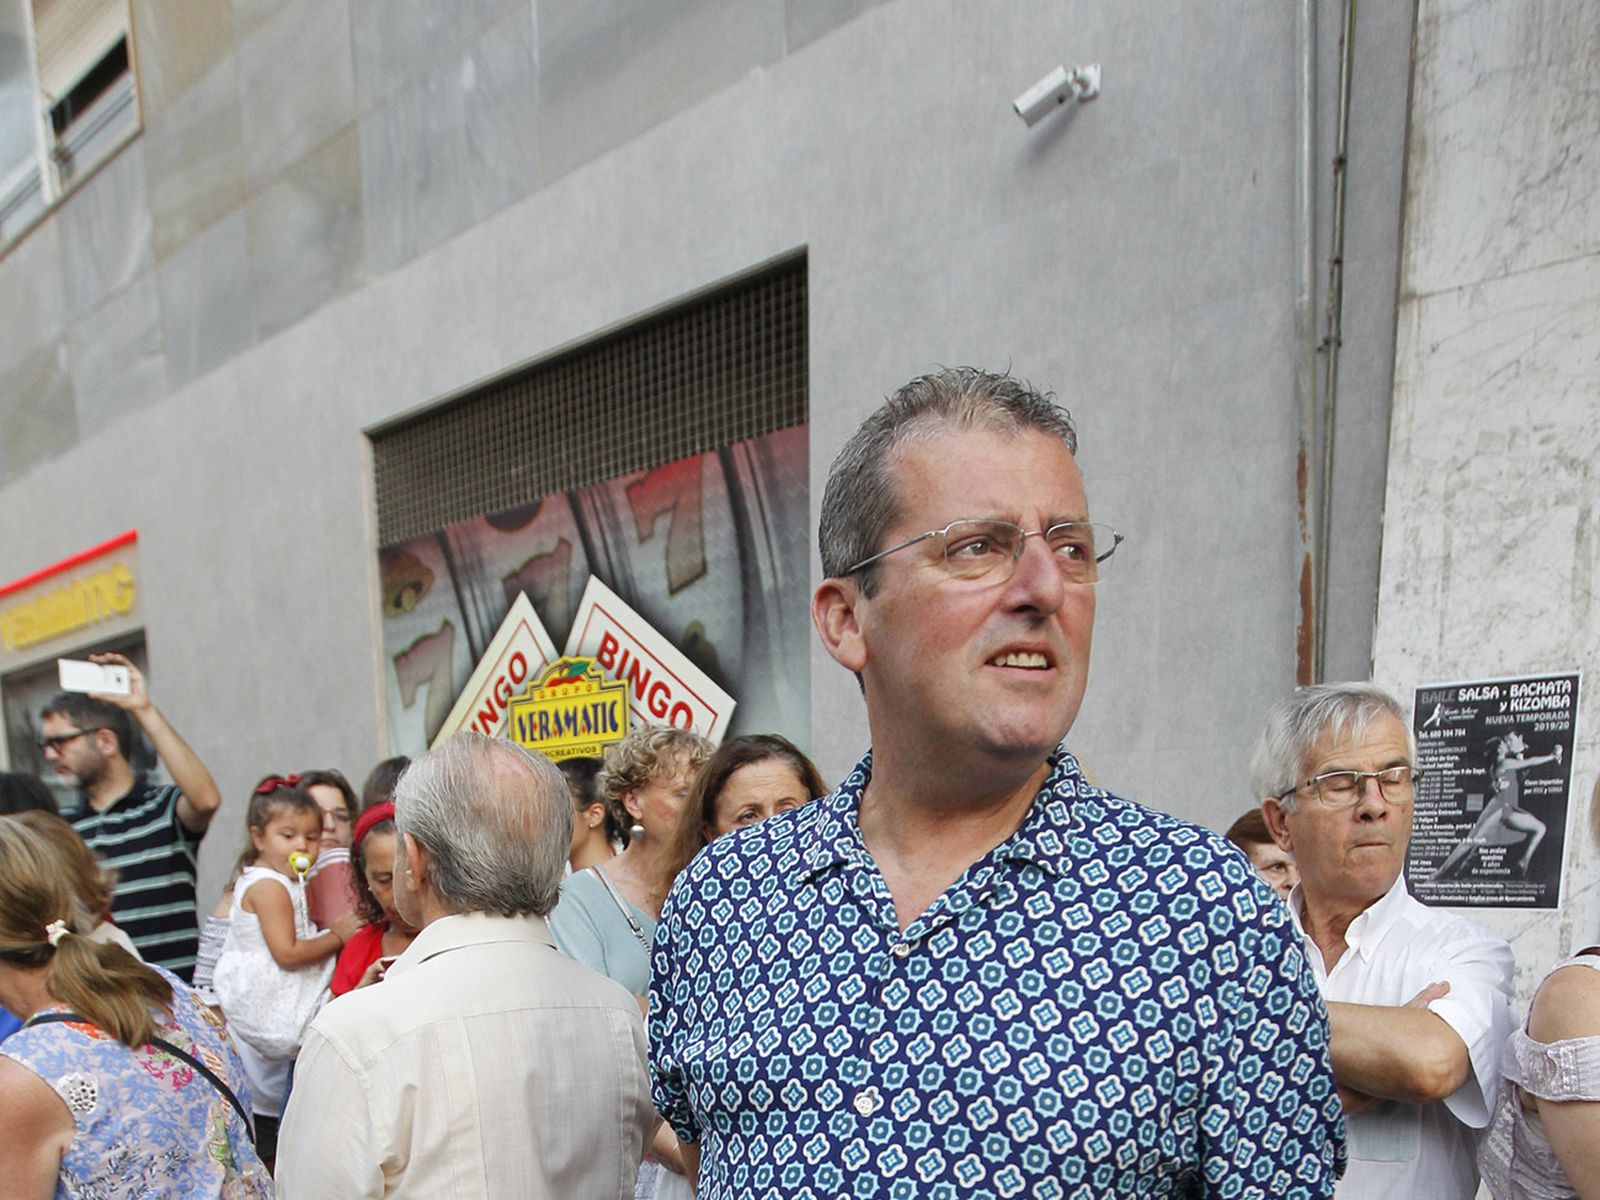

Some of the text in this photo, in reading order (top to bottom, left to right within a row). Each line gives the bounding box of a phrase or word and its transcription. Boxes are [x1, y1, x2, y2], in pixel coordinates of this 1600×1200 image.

[538, 683, 593, 700] GRUPO
[596, 629, 694, 734] BINGO
[1457, 686, 1500, 702] SALSA
[1509, 680, 1572, 698] BACHATA
[469, 650, 528, 736] NGO
[1499, 695, 1571, 713] y KIZOMBA
[516, 699, 619, 743] VERAMATIC
[1485, 715, 1515, 725] NUEVA
[1516, 711, 1570, 723] TEMPORADA
[545, 745, 598, 758] CREATIVOS
